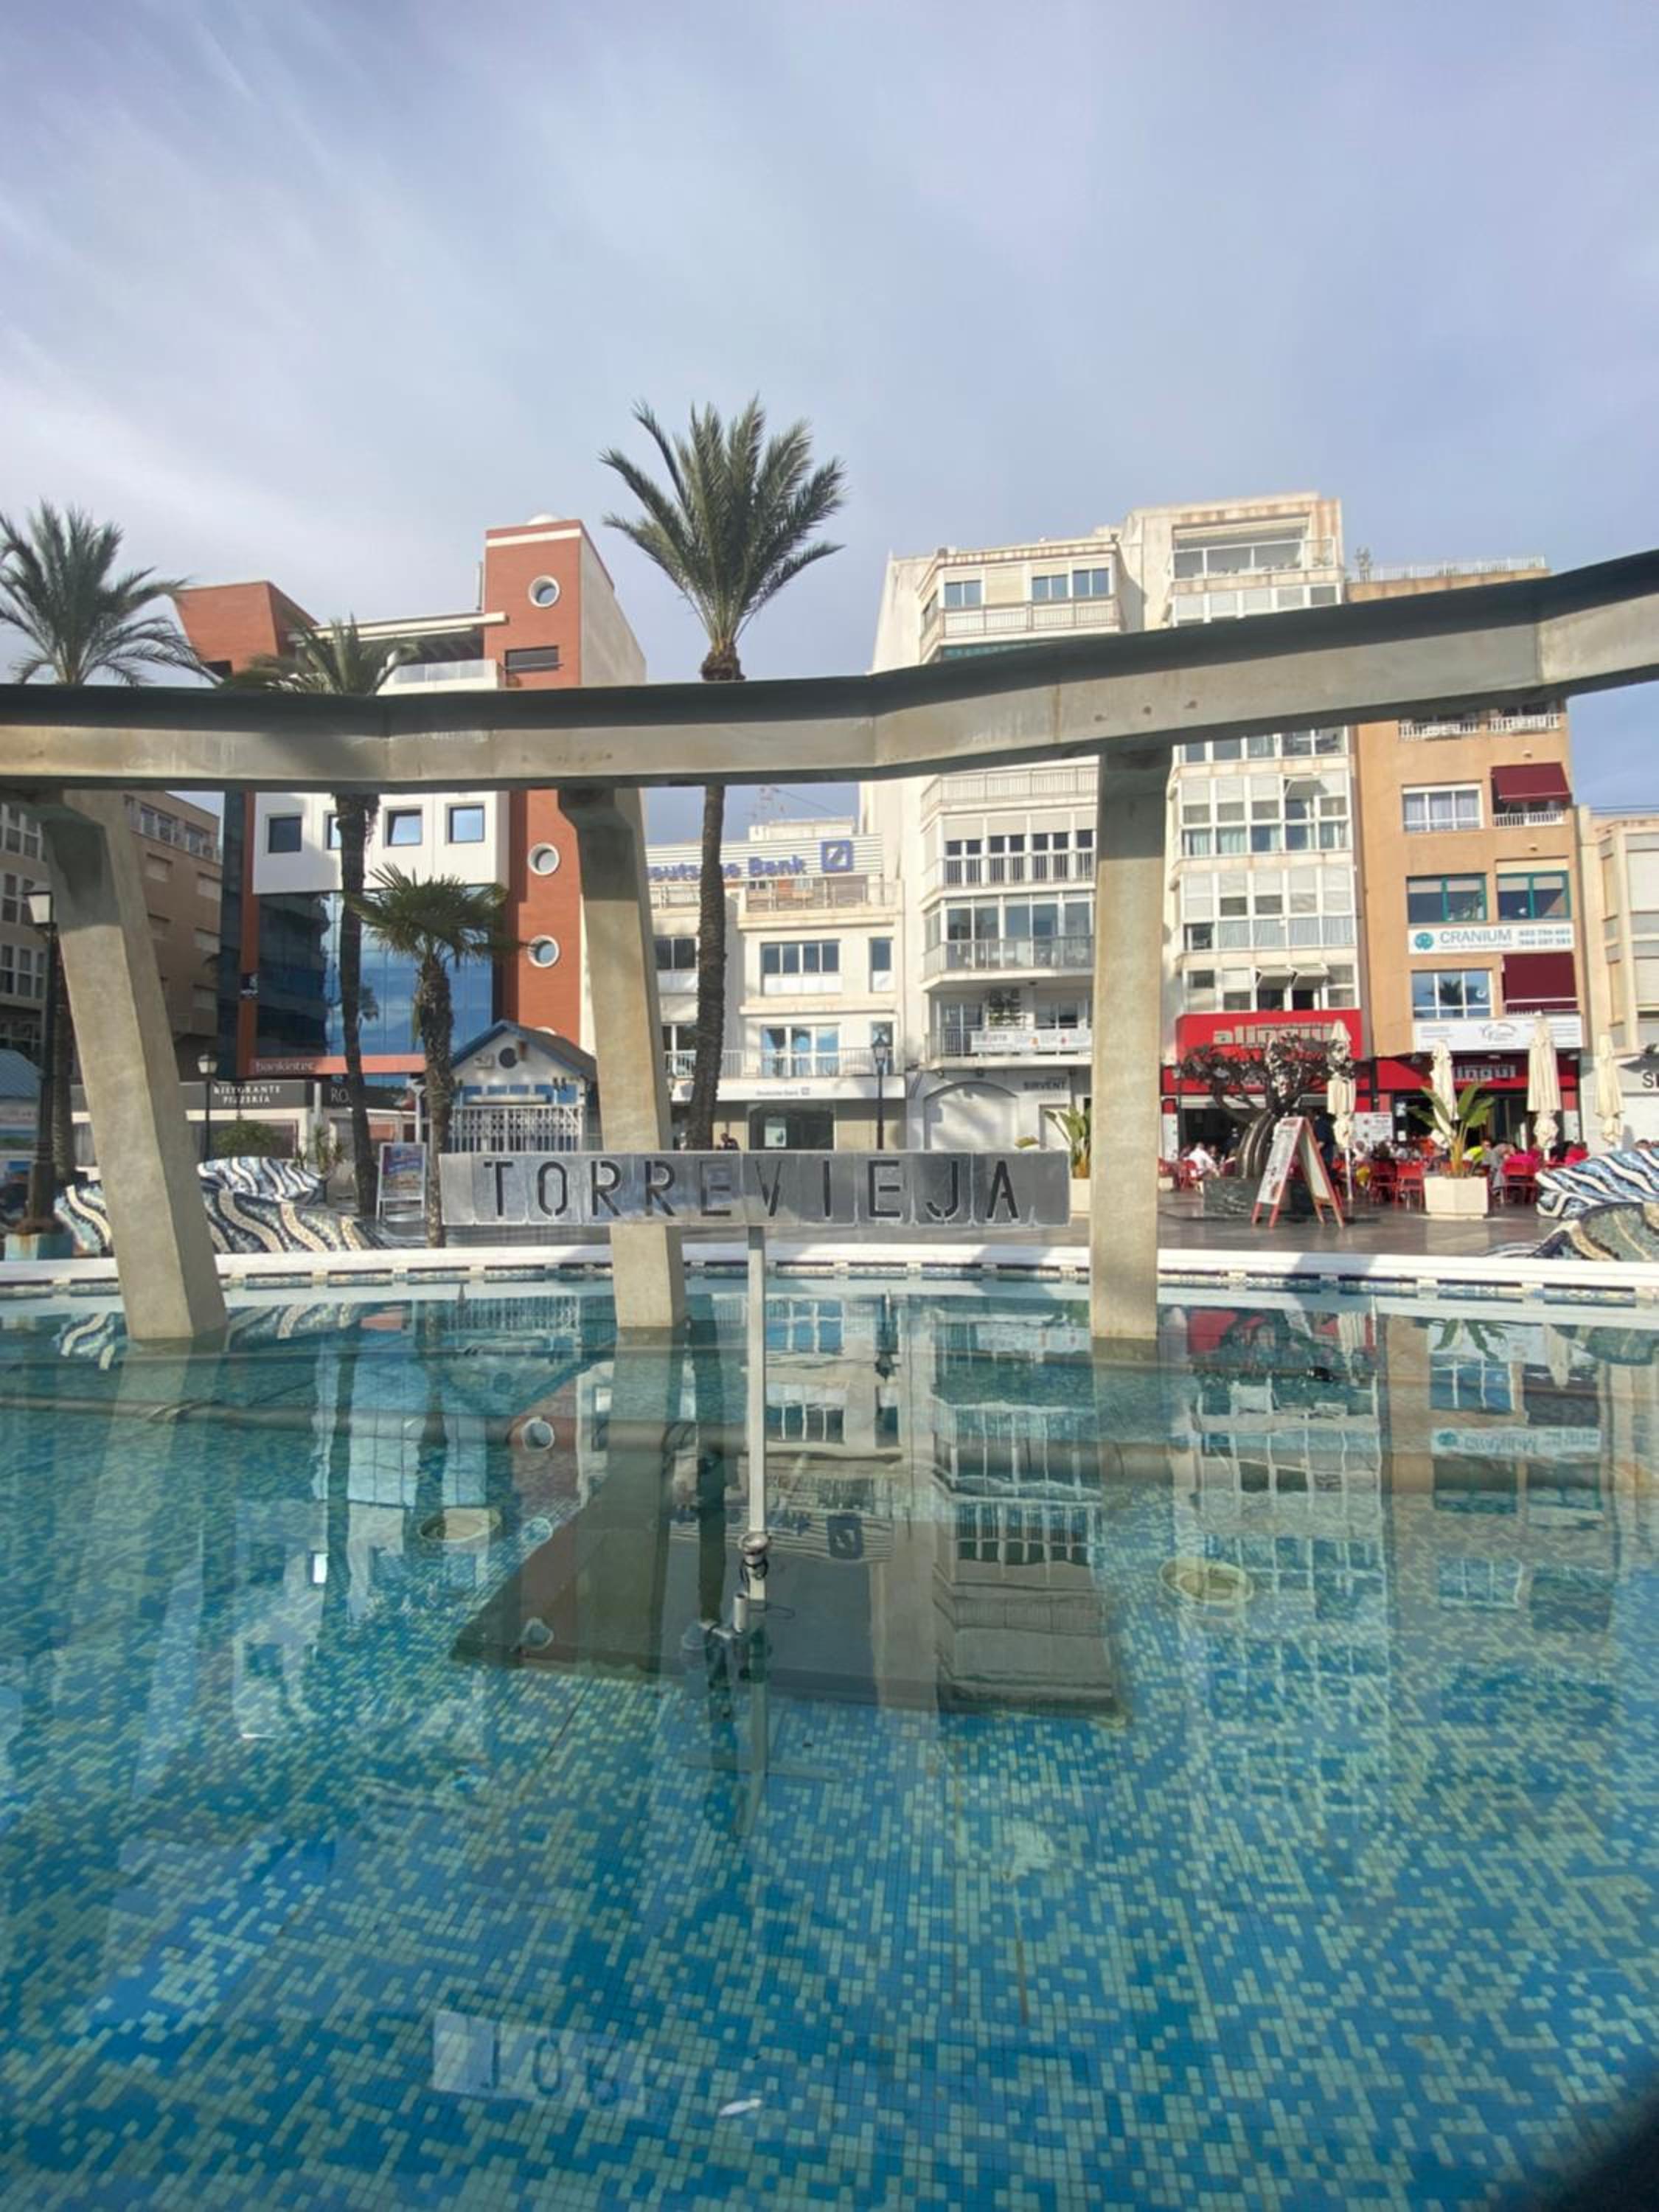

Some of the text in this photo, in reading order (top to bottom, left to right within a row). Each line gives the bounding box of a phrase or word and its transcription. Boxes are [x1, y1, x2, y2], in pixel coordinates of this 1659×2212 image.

[748, 855, 807, 876] Bank
[1439, 929, 1512, 945] CRANIUM
[483, 1160, 1019, 1219] TORREVIEJA
